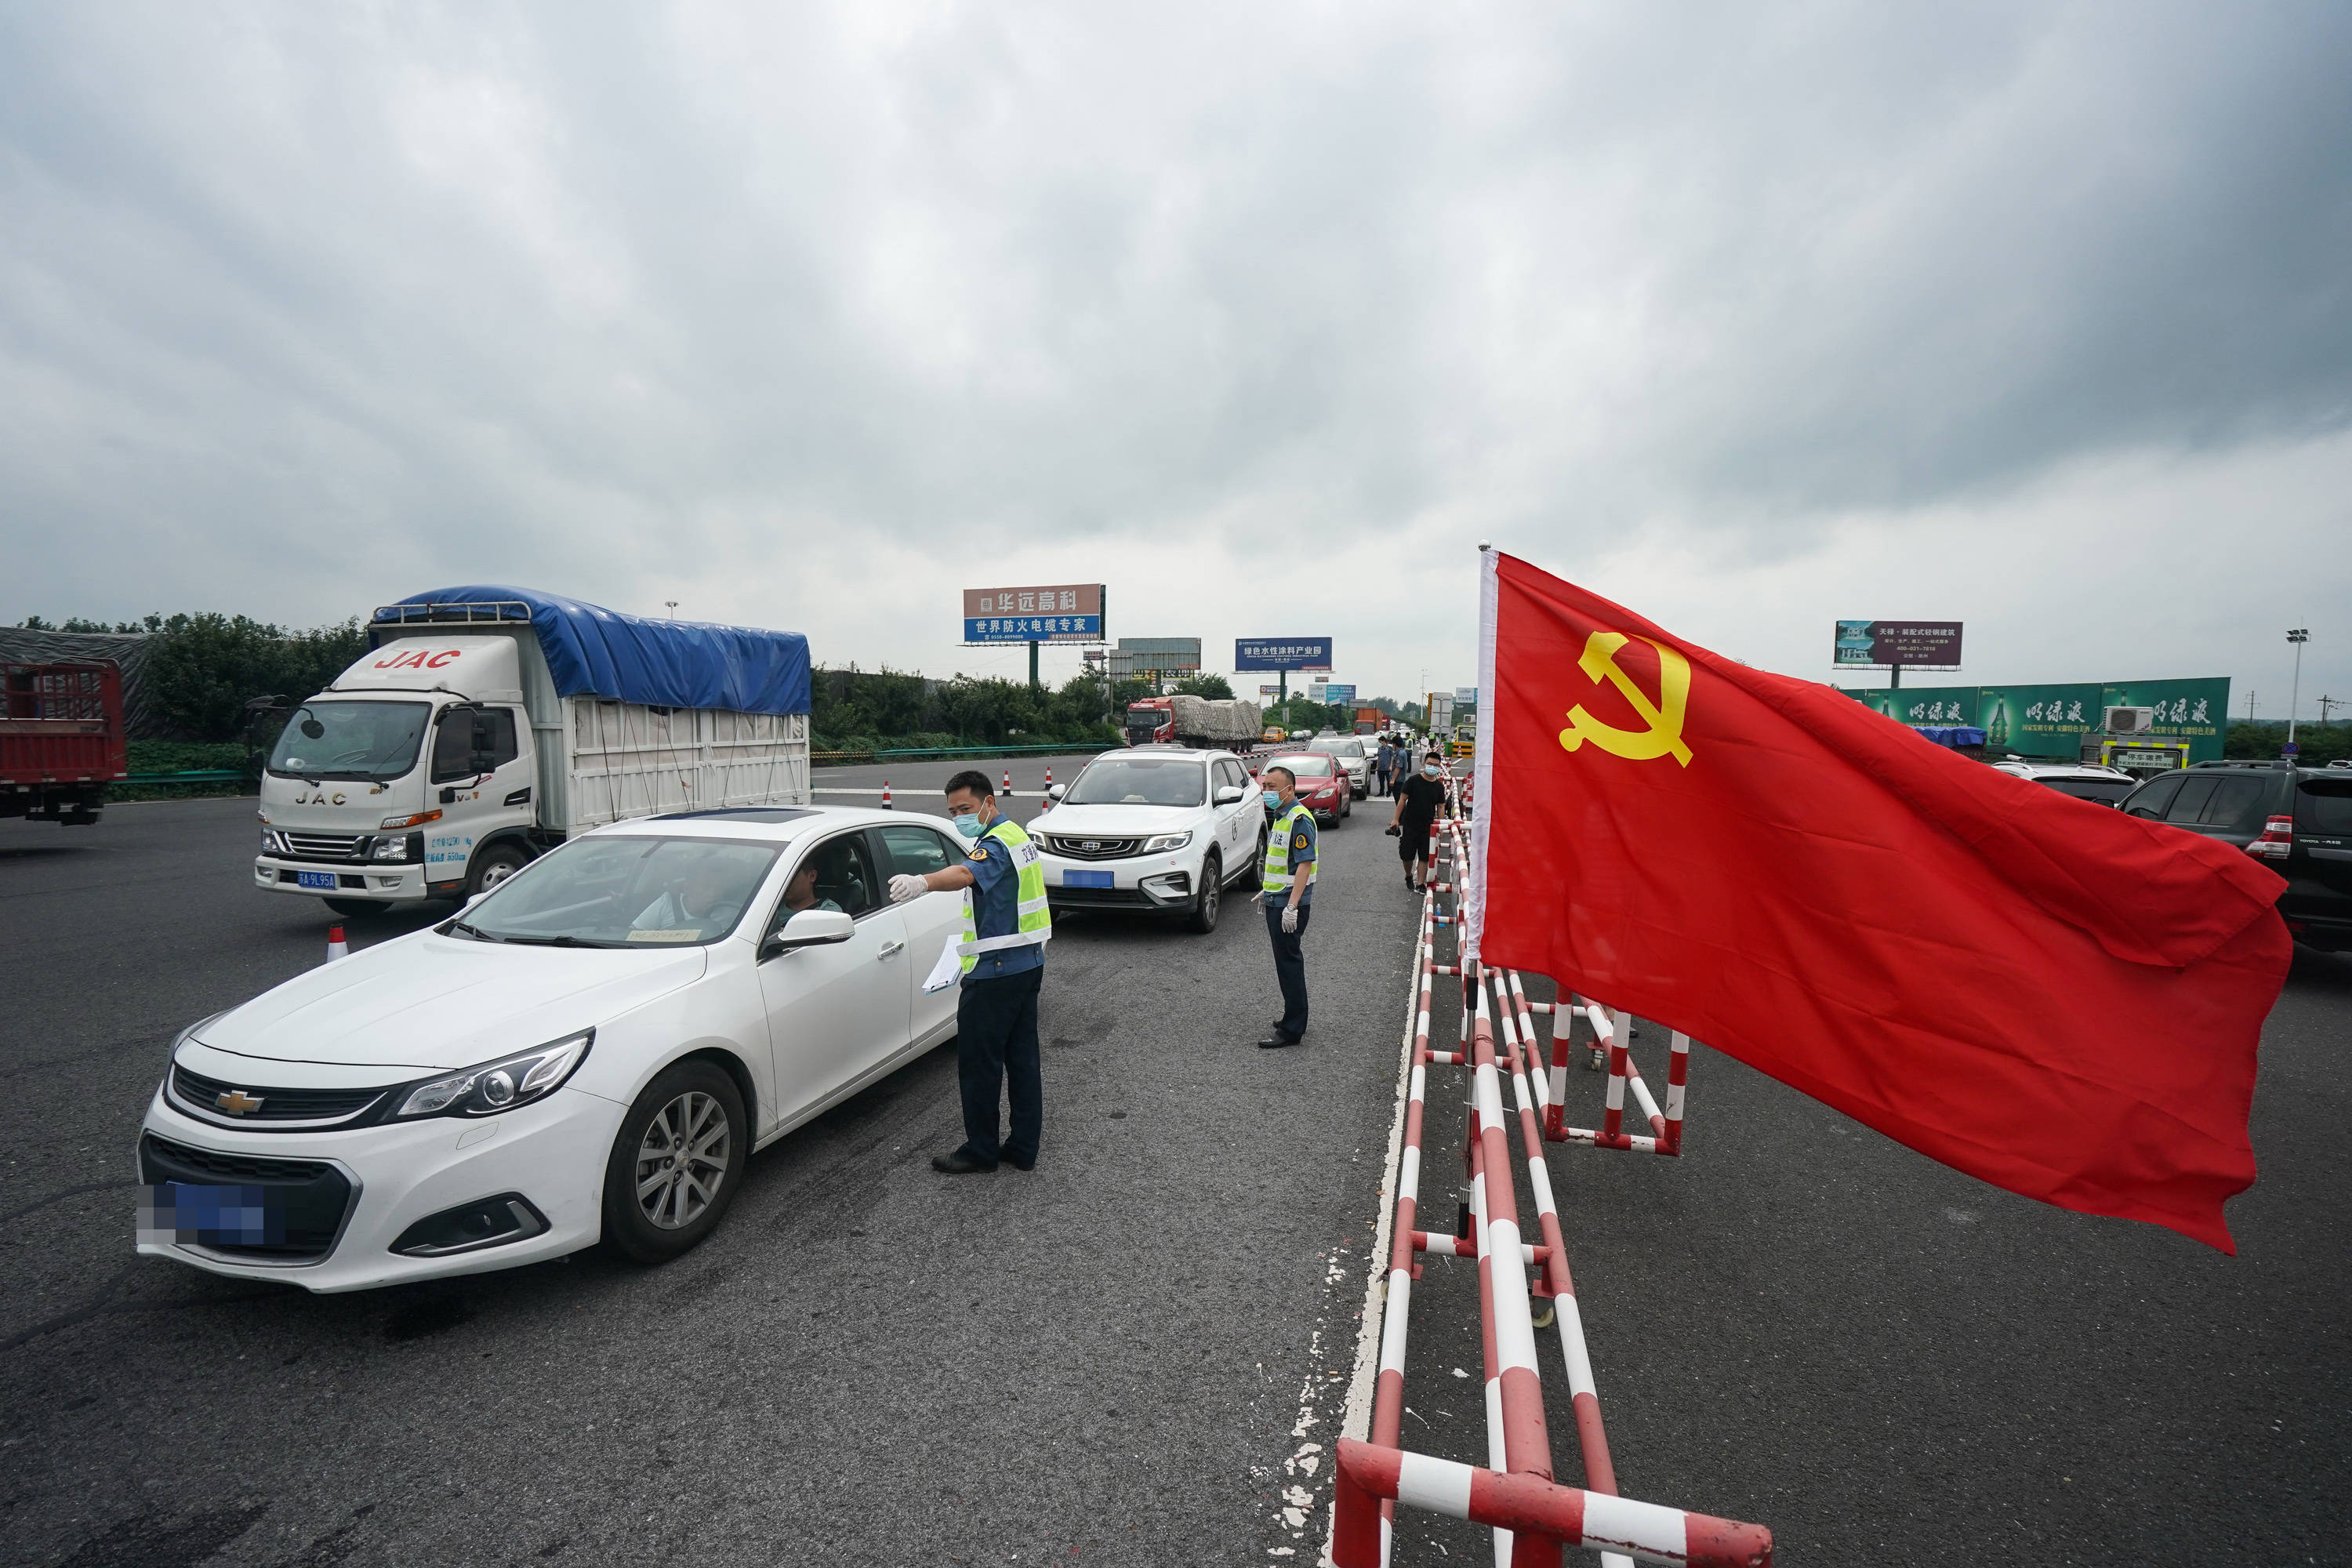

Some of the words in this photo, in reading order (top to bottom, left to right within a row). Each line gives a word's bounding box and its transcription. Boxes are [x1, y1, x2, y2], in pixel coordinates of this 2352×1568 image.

[997, 590, 1076, 612] 华远高科
[976, 617, 1086, 633] 世界防火电缆专家
[1243, 646, 1322, 655] 绿色水性涂料产业园
[374, 650, 461, 669] JAC
[2150, 726, 2178, 735] 家发明专利
[296, 791, 347, 806] JAC
